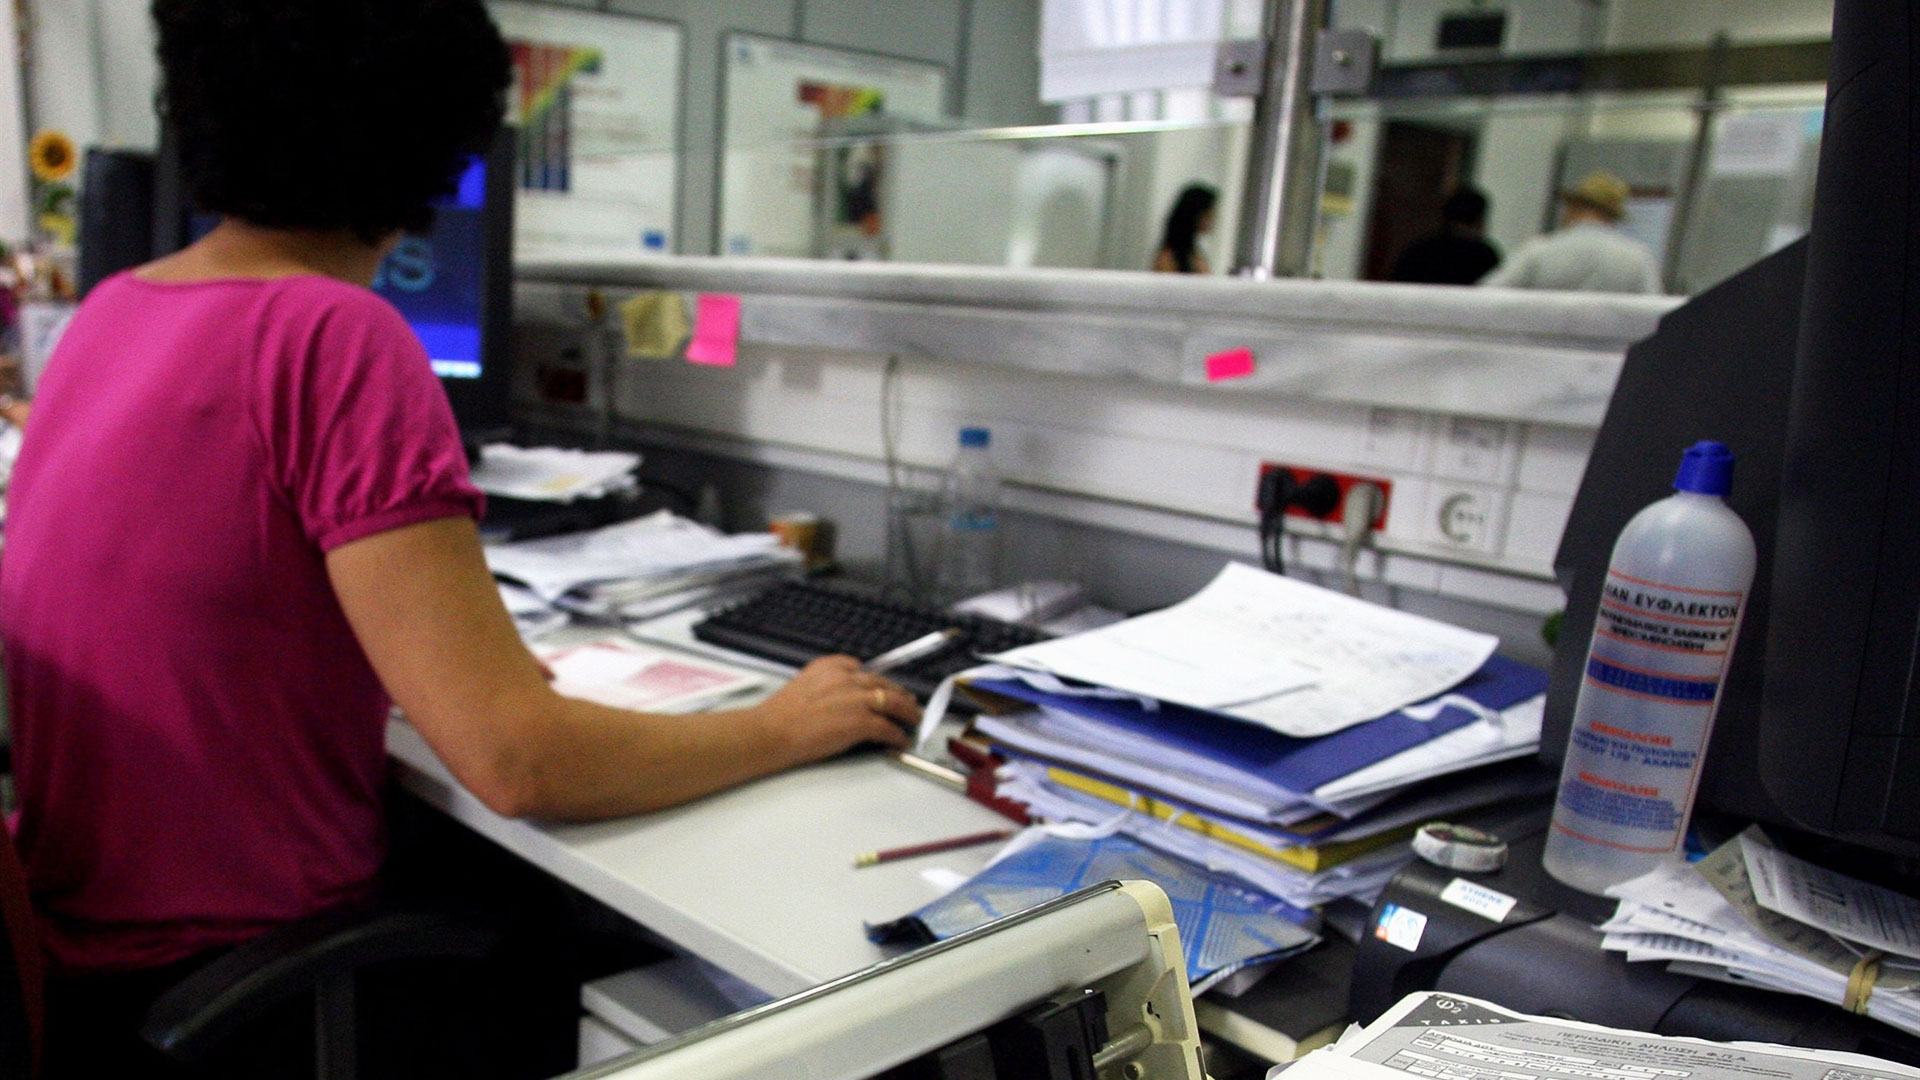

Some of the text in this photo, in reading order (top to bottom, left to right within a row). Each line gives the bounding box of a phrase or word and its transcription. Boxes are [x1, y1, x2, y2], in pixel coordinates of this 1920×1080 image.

[1635, 592, 1738, 618] ΕΥΦΛΕΚΤΟΝ
[1556, 1031, 1632, 1046] ΠΕΡΙΟΔΙΚΗ
[1638, 1042, 1699, 1055] ΔΗΛΩΣΗ
[1706, 1052, 1750, 1063] Φ.Π.Α.
